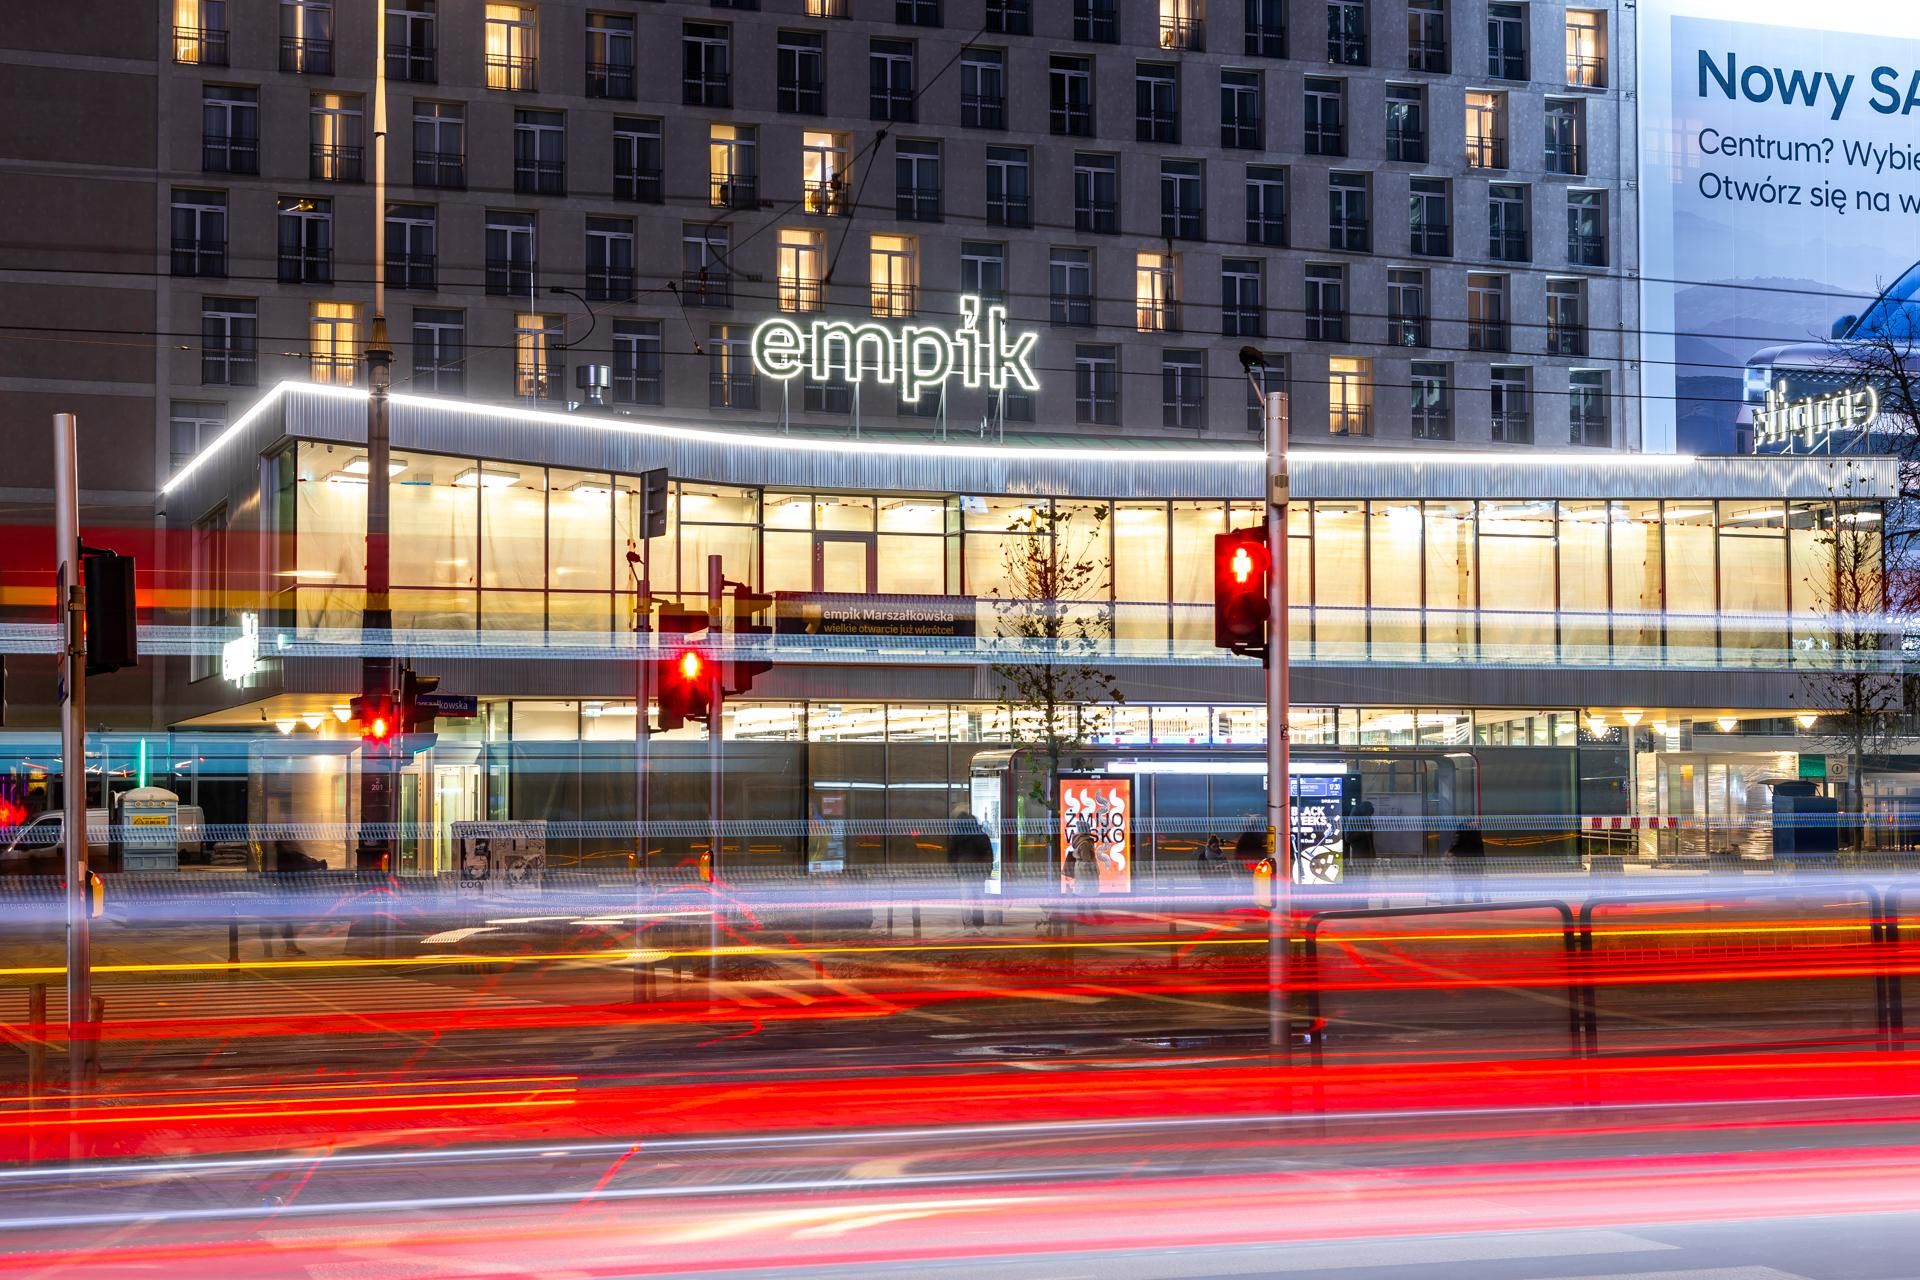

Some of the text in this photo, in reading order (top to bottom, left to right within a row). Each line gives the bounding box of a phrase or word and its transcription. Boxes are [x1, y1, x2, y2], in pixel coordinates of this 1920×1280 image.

[1698, 49, 1855, 121] Nowy
[1698, 128, 1834, 164] Centrum?
[1699, 172, 1802, 206] Otwórz
[1810, 180, 1847, 215] się
[1856, 190, 1890, 212] na
[751, 295, 1040, 402] empik
[824, 606, 954, 622] empik Marszałkowska
[824, 622, 954, 636] wielkie otwarcie już wkrótce!
[1065, 809, 1124, 828] ŻMIJO
[1065, 828, 1125, 844] WSKO
